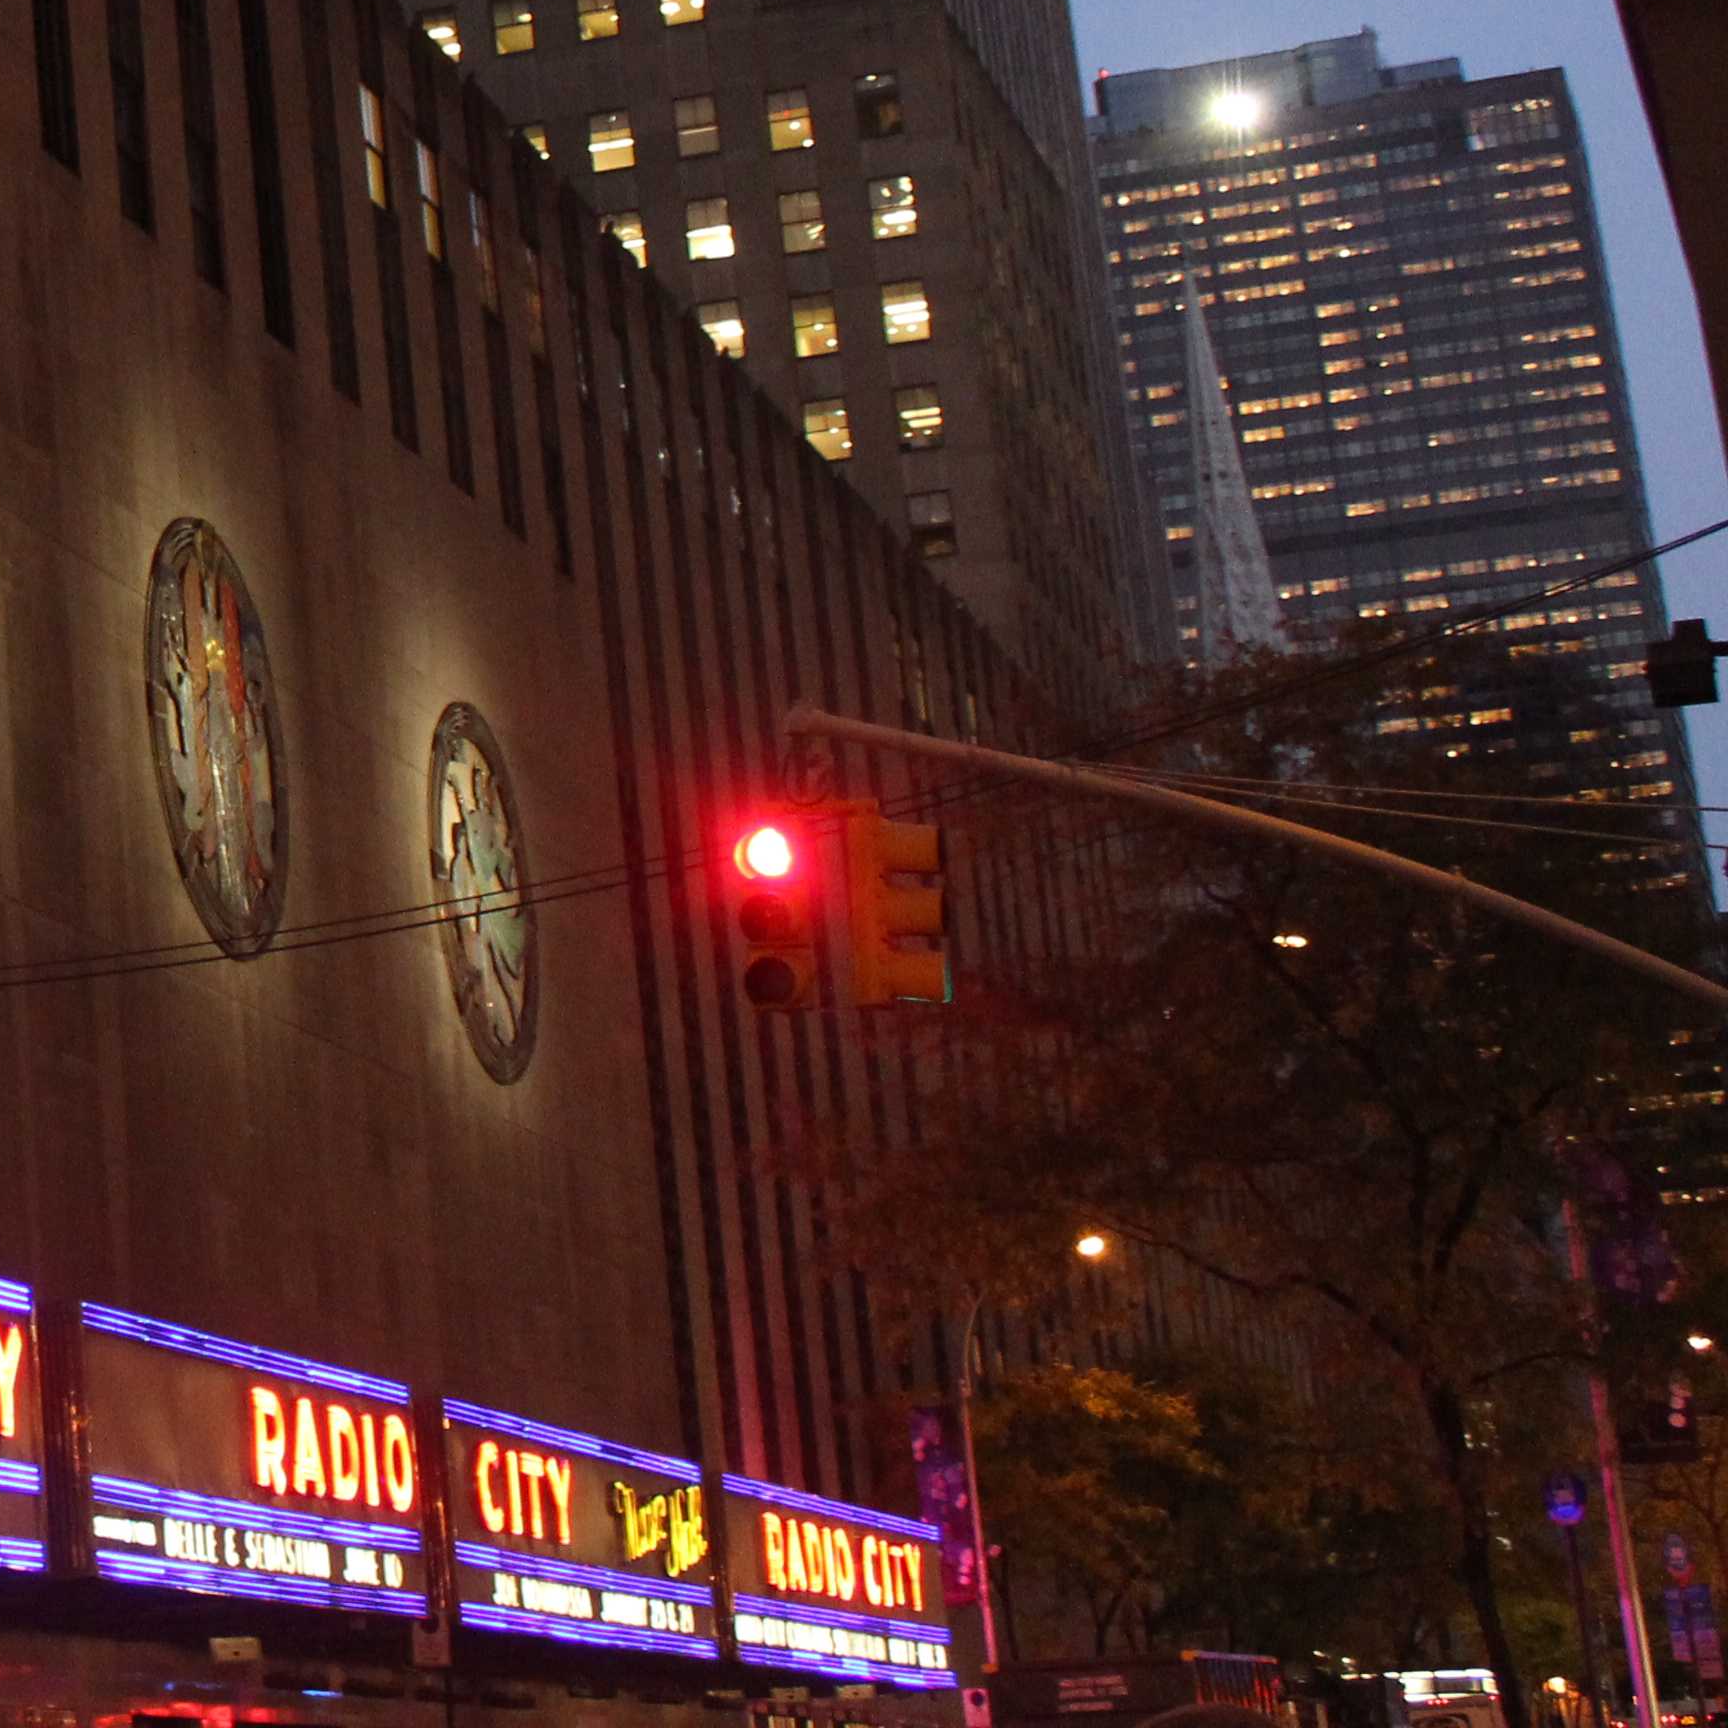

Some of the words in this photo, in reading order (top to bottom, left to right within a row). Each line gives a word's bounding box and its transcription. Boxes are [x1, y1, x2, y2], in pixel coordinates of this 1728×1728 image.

[250, 1386, 415, 1513] RADIO
[476, 1439, 572, 1546] CITY
[761, 1510, 857, 1601] RADIO
[862, 1535, 924, 1613] CITY
